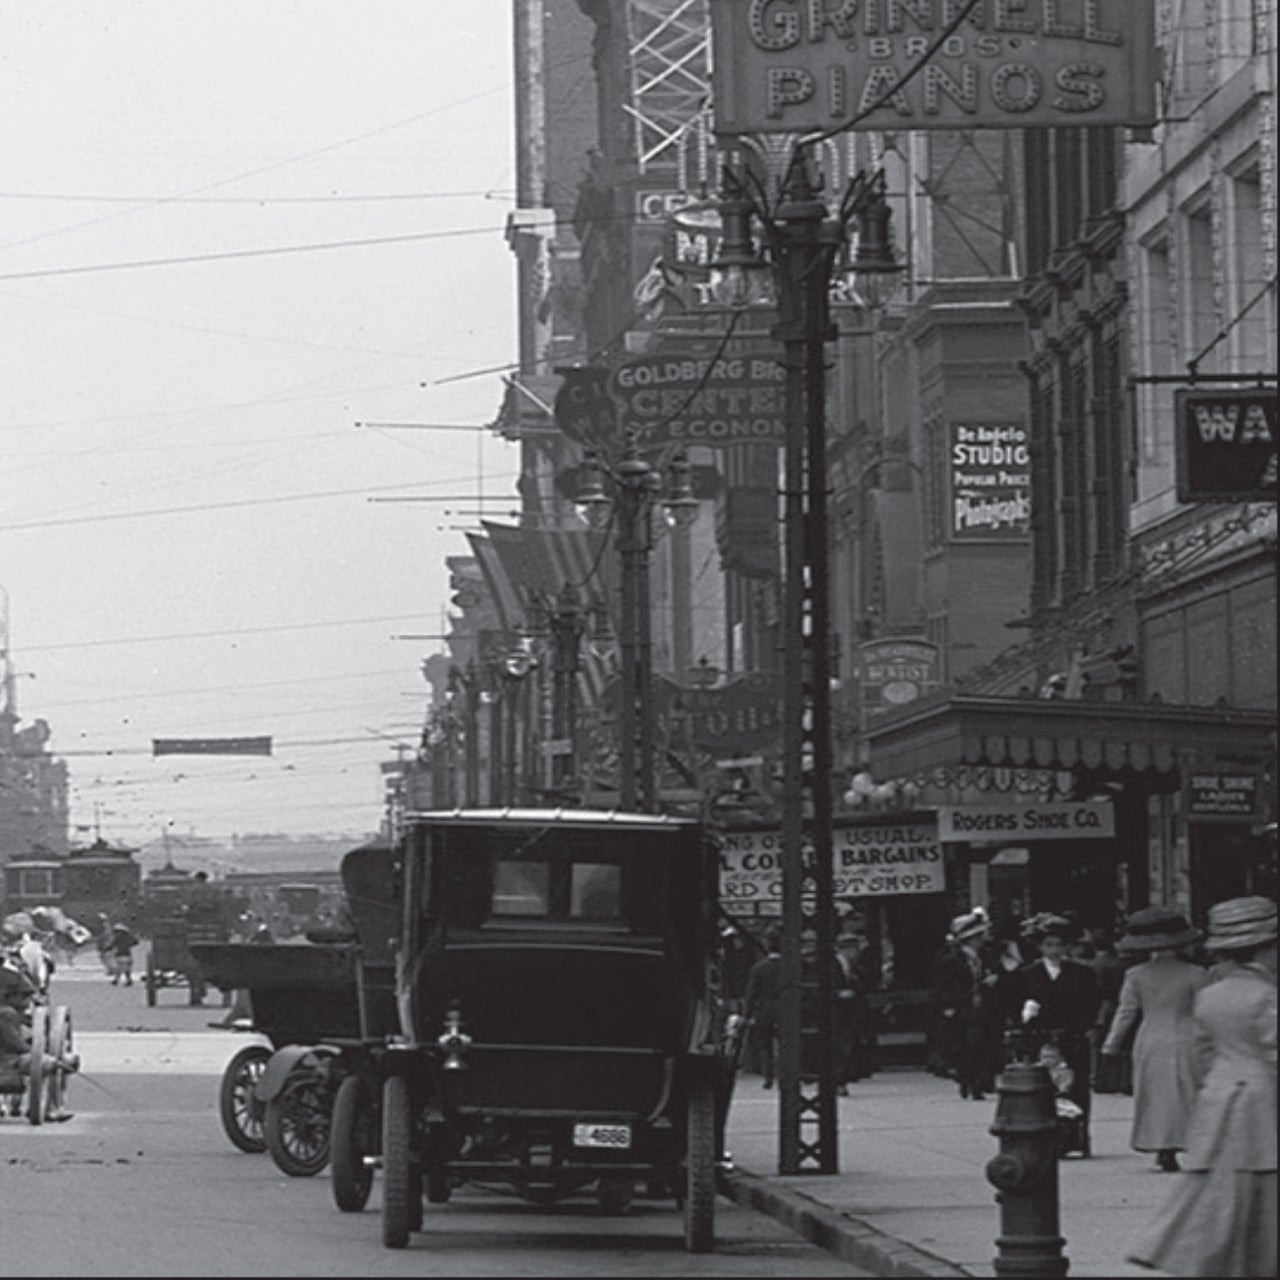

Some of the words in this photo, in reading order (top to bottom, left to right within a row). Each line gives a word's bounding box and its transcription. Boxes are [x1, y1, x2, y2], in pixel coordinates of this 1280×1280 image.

[766, 62, 1106, 120] PIANOS
[618, 361, 742, 387] GOLDBERG
[632, 388, 785, 416] CENTE
[952, 812, 1017, 832] ROGERS
[1023, 809, 1070, 830] SHOE
[842, 845, 938, 867] BARGAINS
